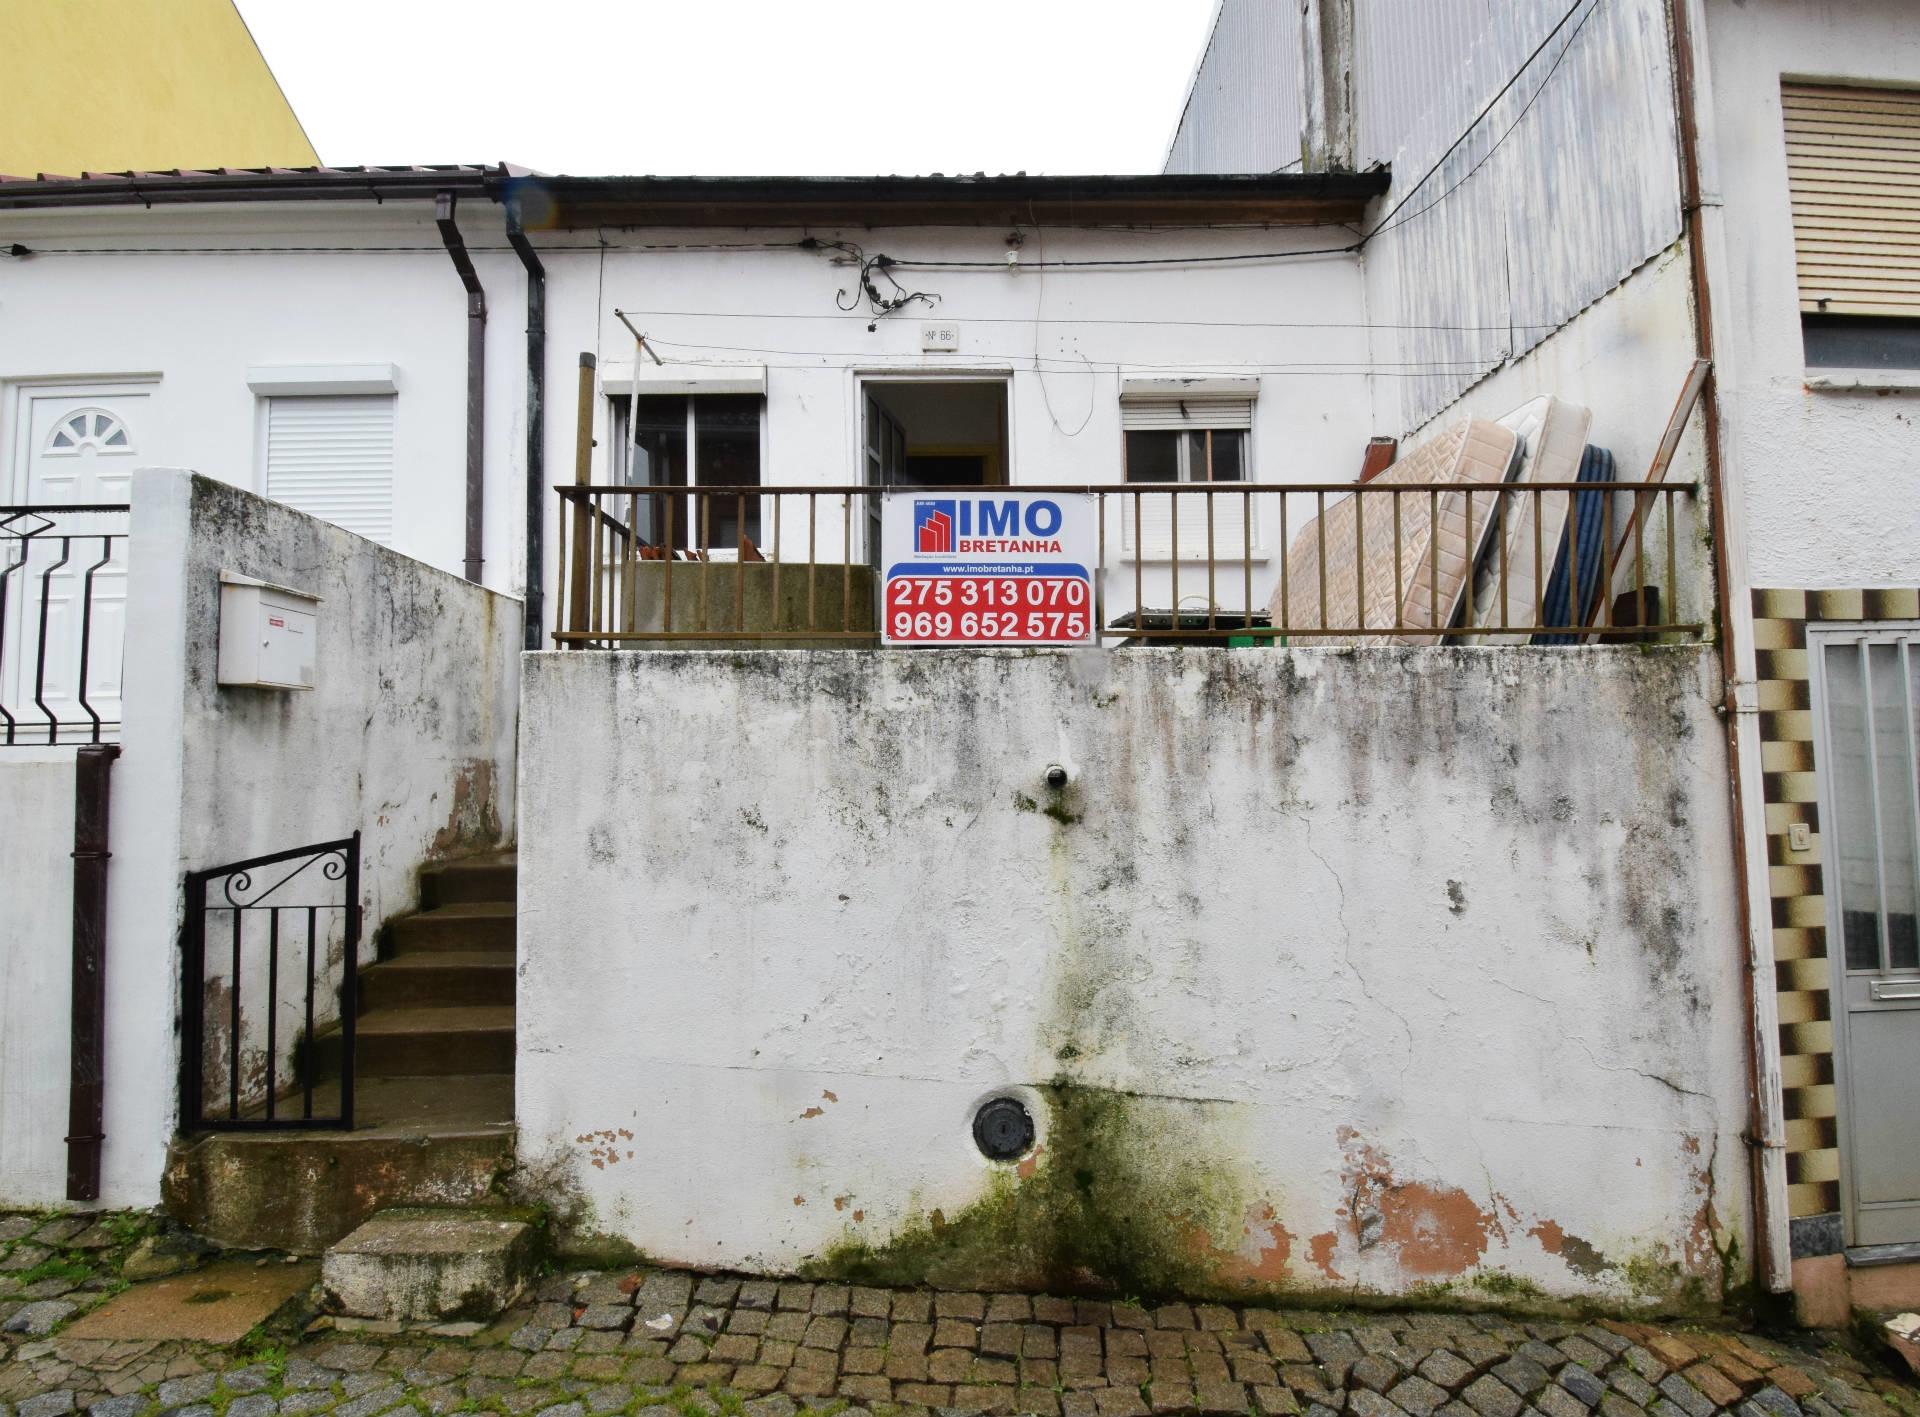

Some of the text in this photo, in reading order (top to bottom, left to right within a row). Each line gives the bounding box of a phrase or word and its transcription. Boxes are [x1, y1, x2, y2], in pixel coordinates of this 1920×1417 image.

[940, 330, 952, 341] 66
[959, 500, 1063, 537] IMO
[959, 540, 1063, 553] BRETANHA
[943, 565, 1034, 574] www.imobretanha.pt
[894, 580, 1084, 605] 275 313 070
[894, 612, 1084, 637] 969 652 575
